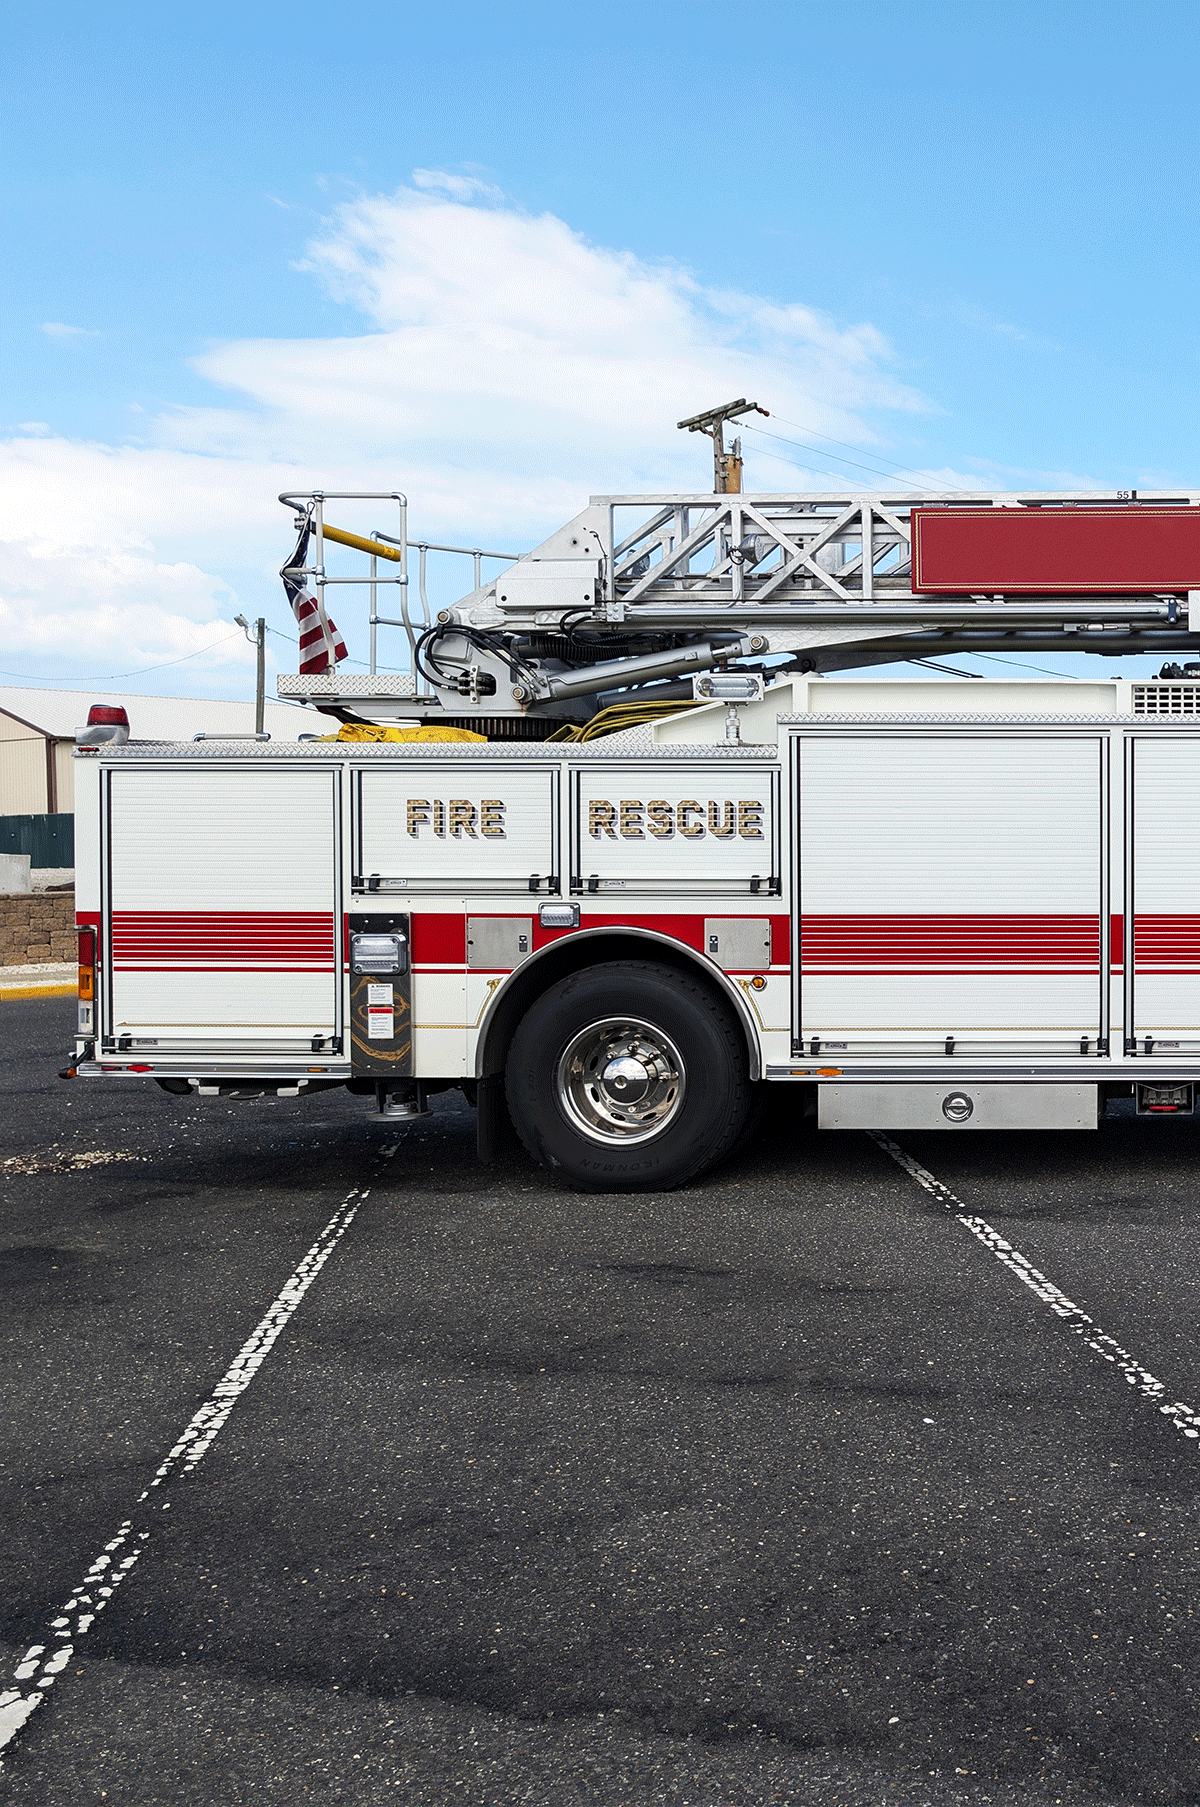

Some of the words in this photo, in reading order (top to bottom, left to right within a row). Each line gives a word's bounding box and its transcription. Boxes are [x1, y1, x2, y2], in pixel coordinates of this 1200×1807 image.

[1116, 490, 1129, 499] 55
[406, 799, 507, 840] FIRE
[588, 800, 765, 841] RESCUE
[580, 1157, 660, 1172] IRONMAN
